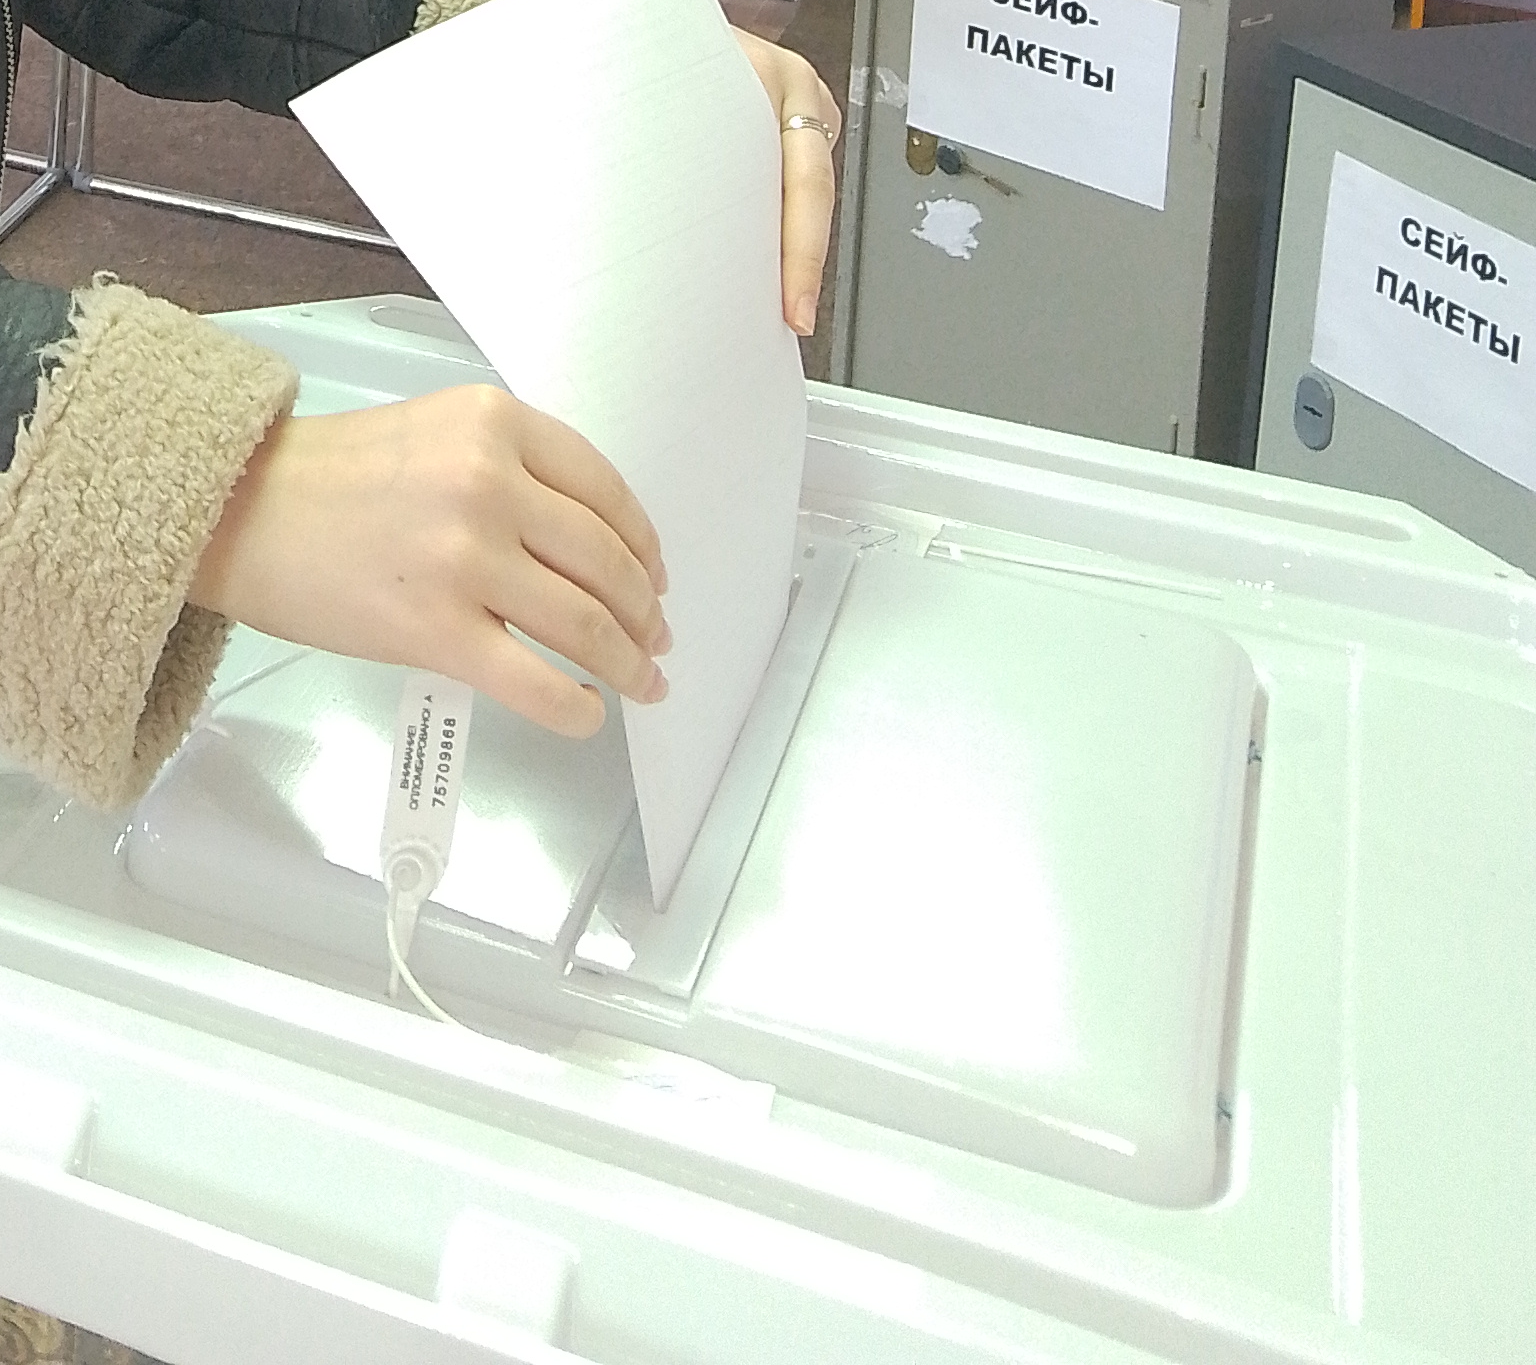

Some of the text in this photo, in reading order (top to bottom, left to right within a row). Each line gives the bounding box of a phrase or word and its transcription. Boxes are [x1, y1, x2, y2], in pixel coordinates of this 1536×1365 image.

[966, 25, 1115, 93] ПАКЕТЫ
[1400, 217, 1508, 286] СЕЙФ-
[1375, 266, 1521, 365] ПАКЕТЫ
